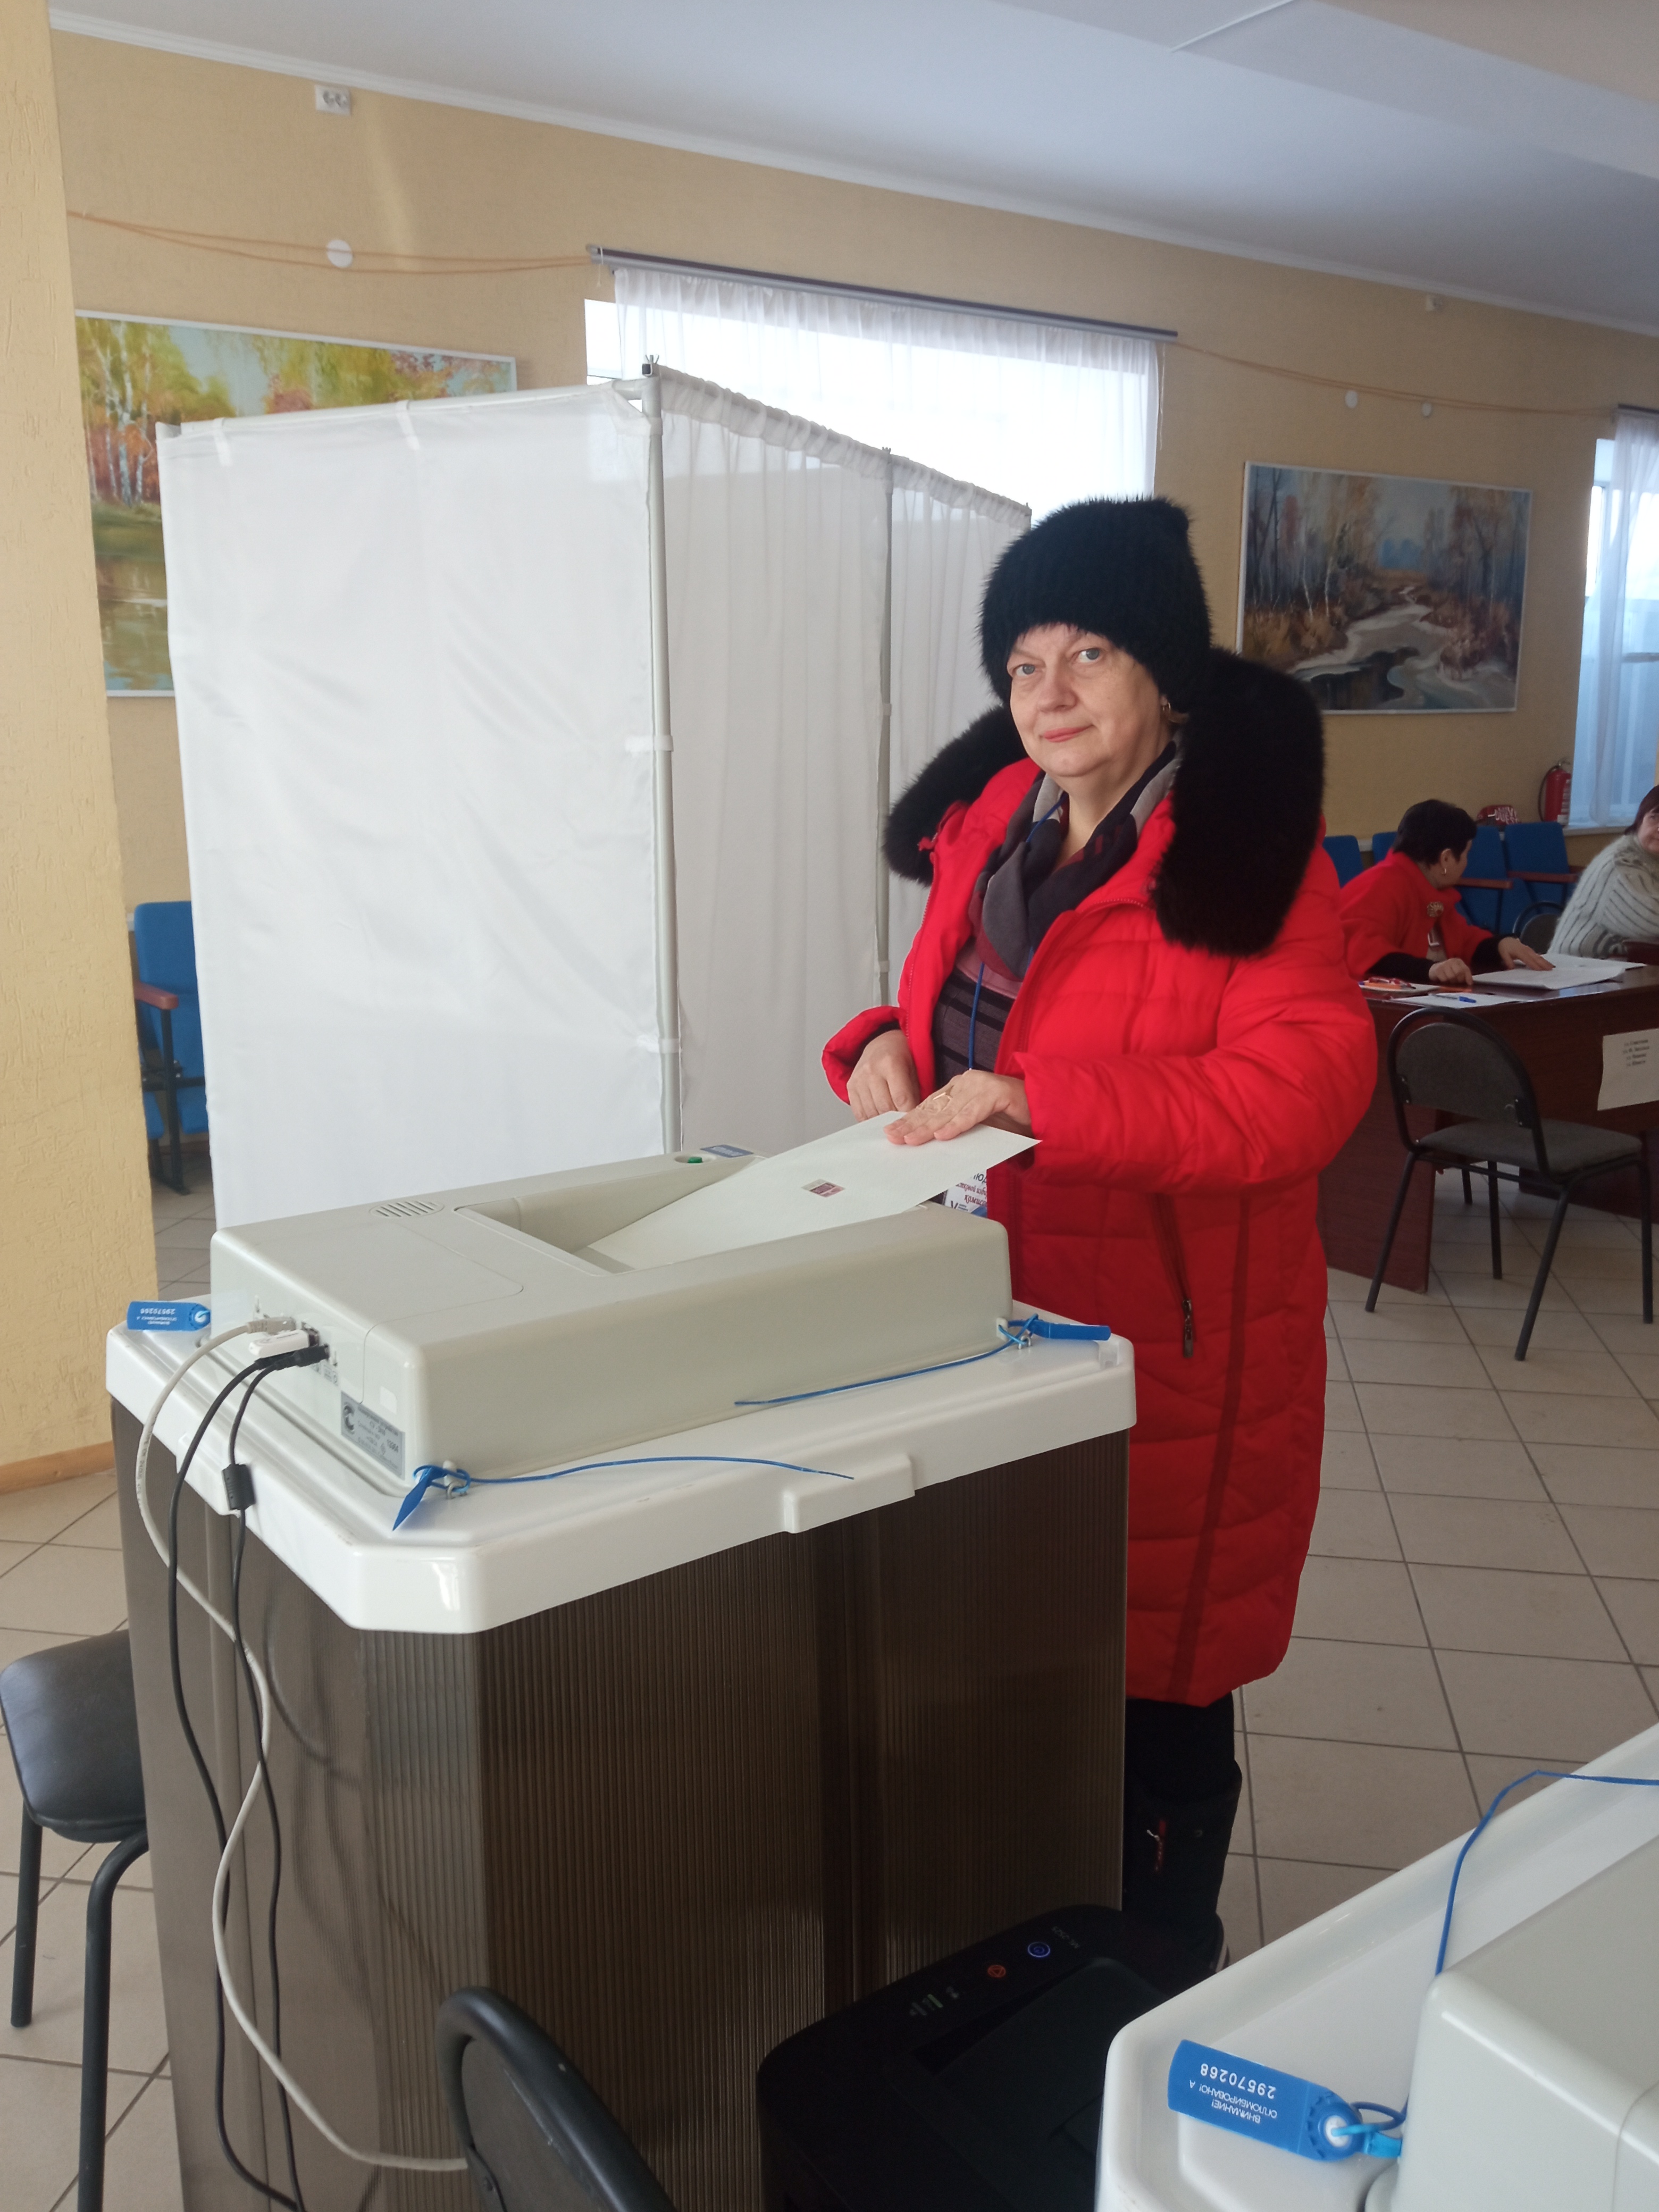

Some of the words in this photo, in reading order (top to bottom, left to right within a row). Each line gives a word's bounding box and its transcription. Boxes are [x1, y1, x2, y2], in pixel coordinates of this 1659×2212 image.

[1200, 2063, 1276, 2099] 29570268
[1199, 2083, 1278, 2118] ОПЛОМБИРОВАНО!
[1211, 2098, 1261, 2124] ВНИМАНИЕ!
